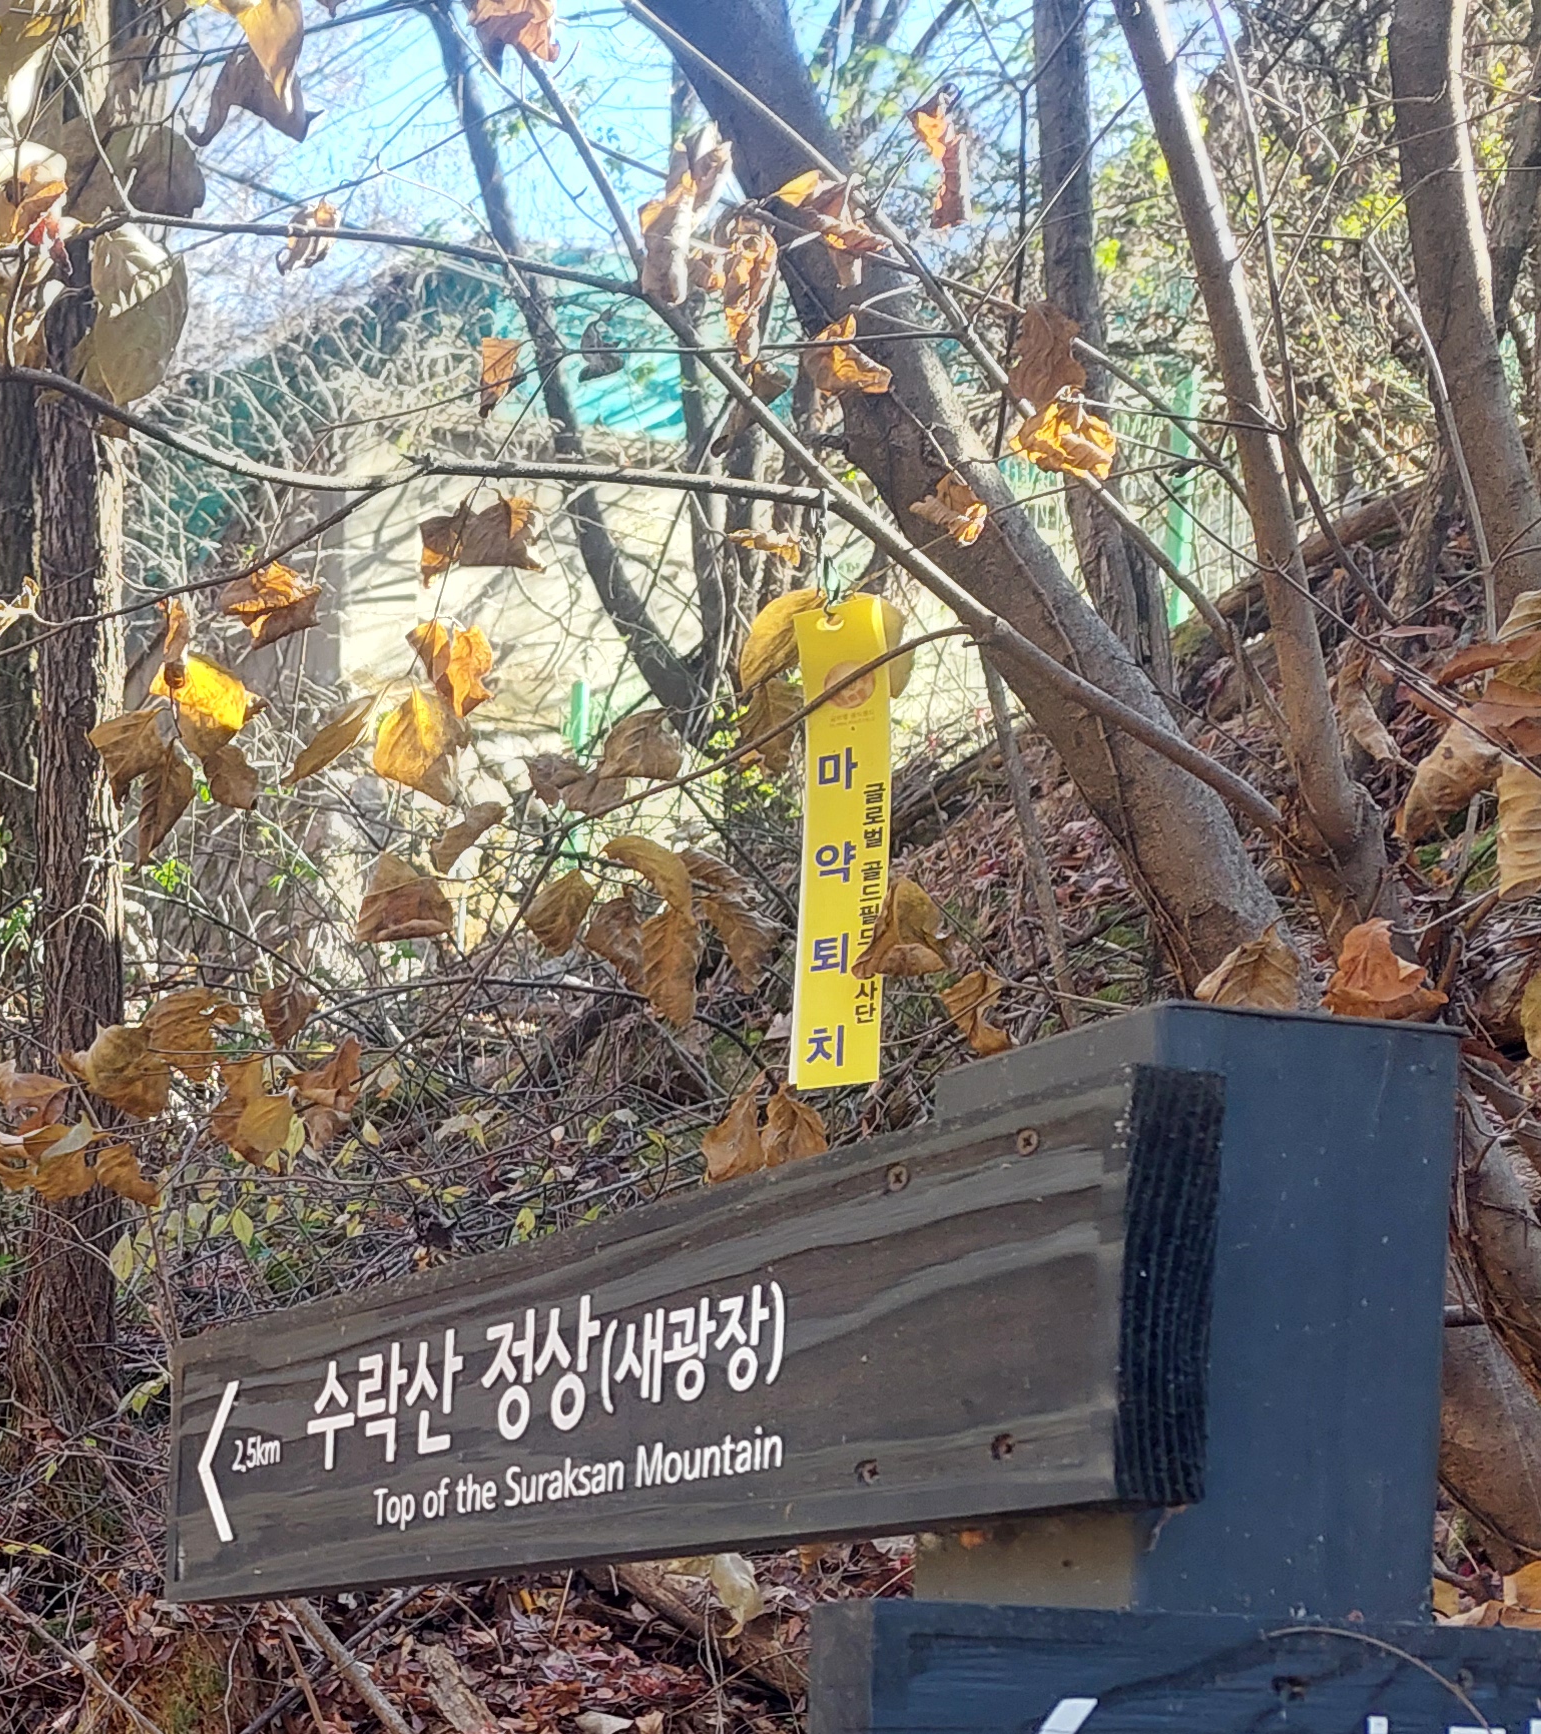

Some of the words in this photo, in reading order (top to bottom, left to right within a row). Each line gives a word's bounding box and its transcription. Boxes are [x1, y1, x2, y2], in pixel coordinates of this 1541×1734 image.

[862, 781, 887, 848] 글로벌
[306, 1329, 464, 1470] 수락산
[480, 1281, 785, 1440] 정상(새광장)
[373, 1487, 415, 1530] Top
[422, 1477, 451, 1519] of
[455, 1474, 498, 1516] the
[505, 1455, 625, 1508] Suraksan
[634, 1426, 782, 1489] Mountain
